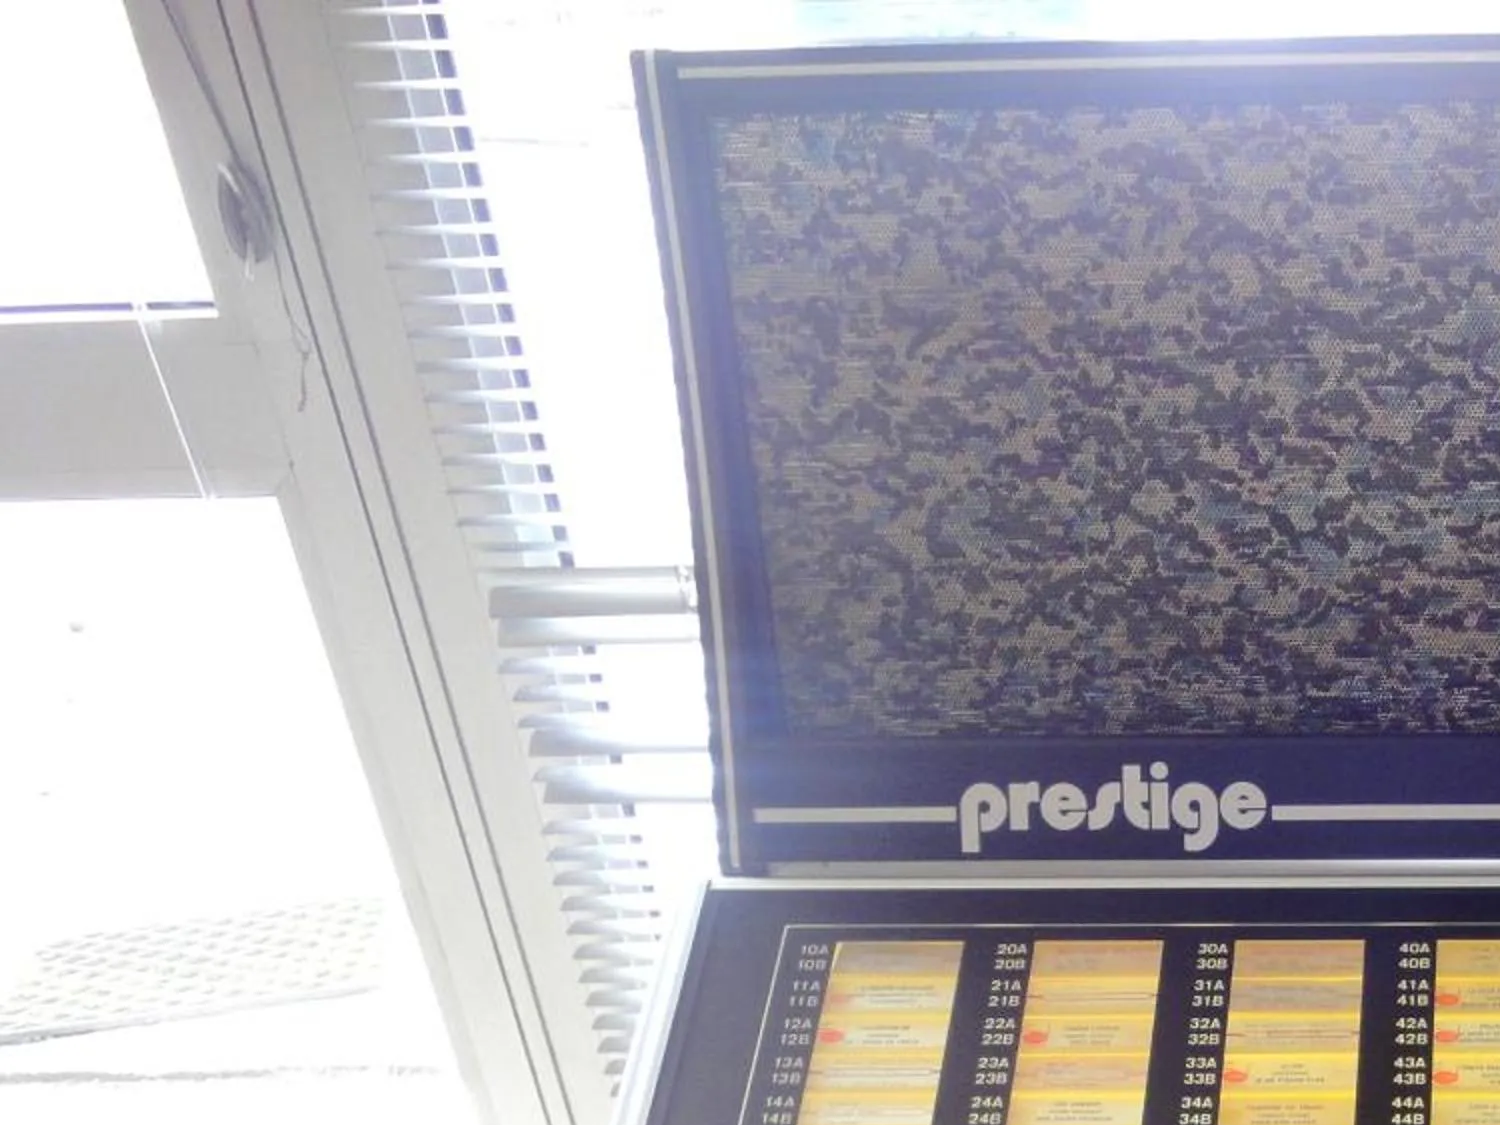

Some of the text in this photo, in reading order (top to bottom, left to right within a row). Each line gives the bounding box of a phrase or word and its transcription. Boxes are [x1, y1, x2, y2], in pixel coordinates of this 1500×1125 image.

[959, 760, 1268, 853] prestige
[1400, 943, 1430, 954] 40A
[1194, 980, 1224, 990] 31A
[1398, 980, 1429, 990] 41A
[1192, 995, 1223, 1006] 31B
[1397, 994, 1428, 1006] 41B
[984, 1018, 1015, 1029] 22A
[1190, 1018, 1220, 1029] 32A
[1396, 1018, 1427, 1029] 42A
[982, 1034, 1014, 1045] 22B
[1188, 1034, 1220, 1045] 32B
[1395, 1033, 1428, 1044] 42B
[978, 1057, 1008, 1068] 23A
[1186, 1057, 1216, 1068] 33A
[1394, 1057, 1426, 1068] 43A
[976, 1072, 1007, 1084] 23B
[1184, 1073, 1216, 1085] 33B
[1394, 1073, 1426, 1084] 43B
[971, 1096, 1003, 1108] 24A
[1181, 1097, 1212, 1108] 34A
[1392, 1097, 1424, 1108] 44A
[969, 1113, 1001, 1125] 24B
[1179, 1114, 1211, 1125] 34B
[1392, 1114, 1424, 1125] 44B
